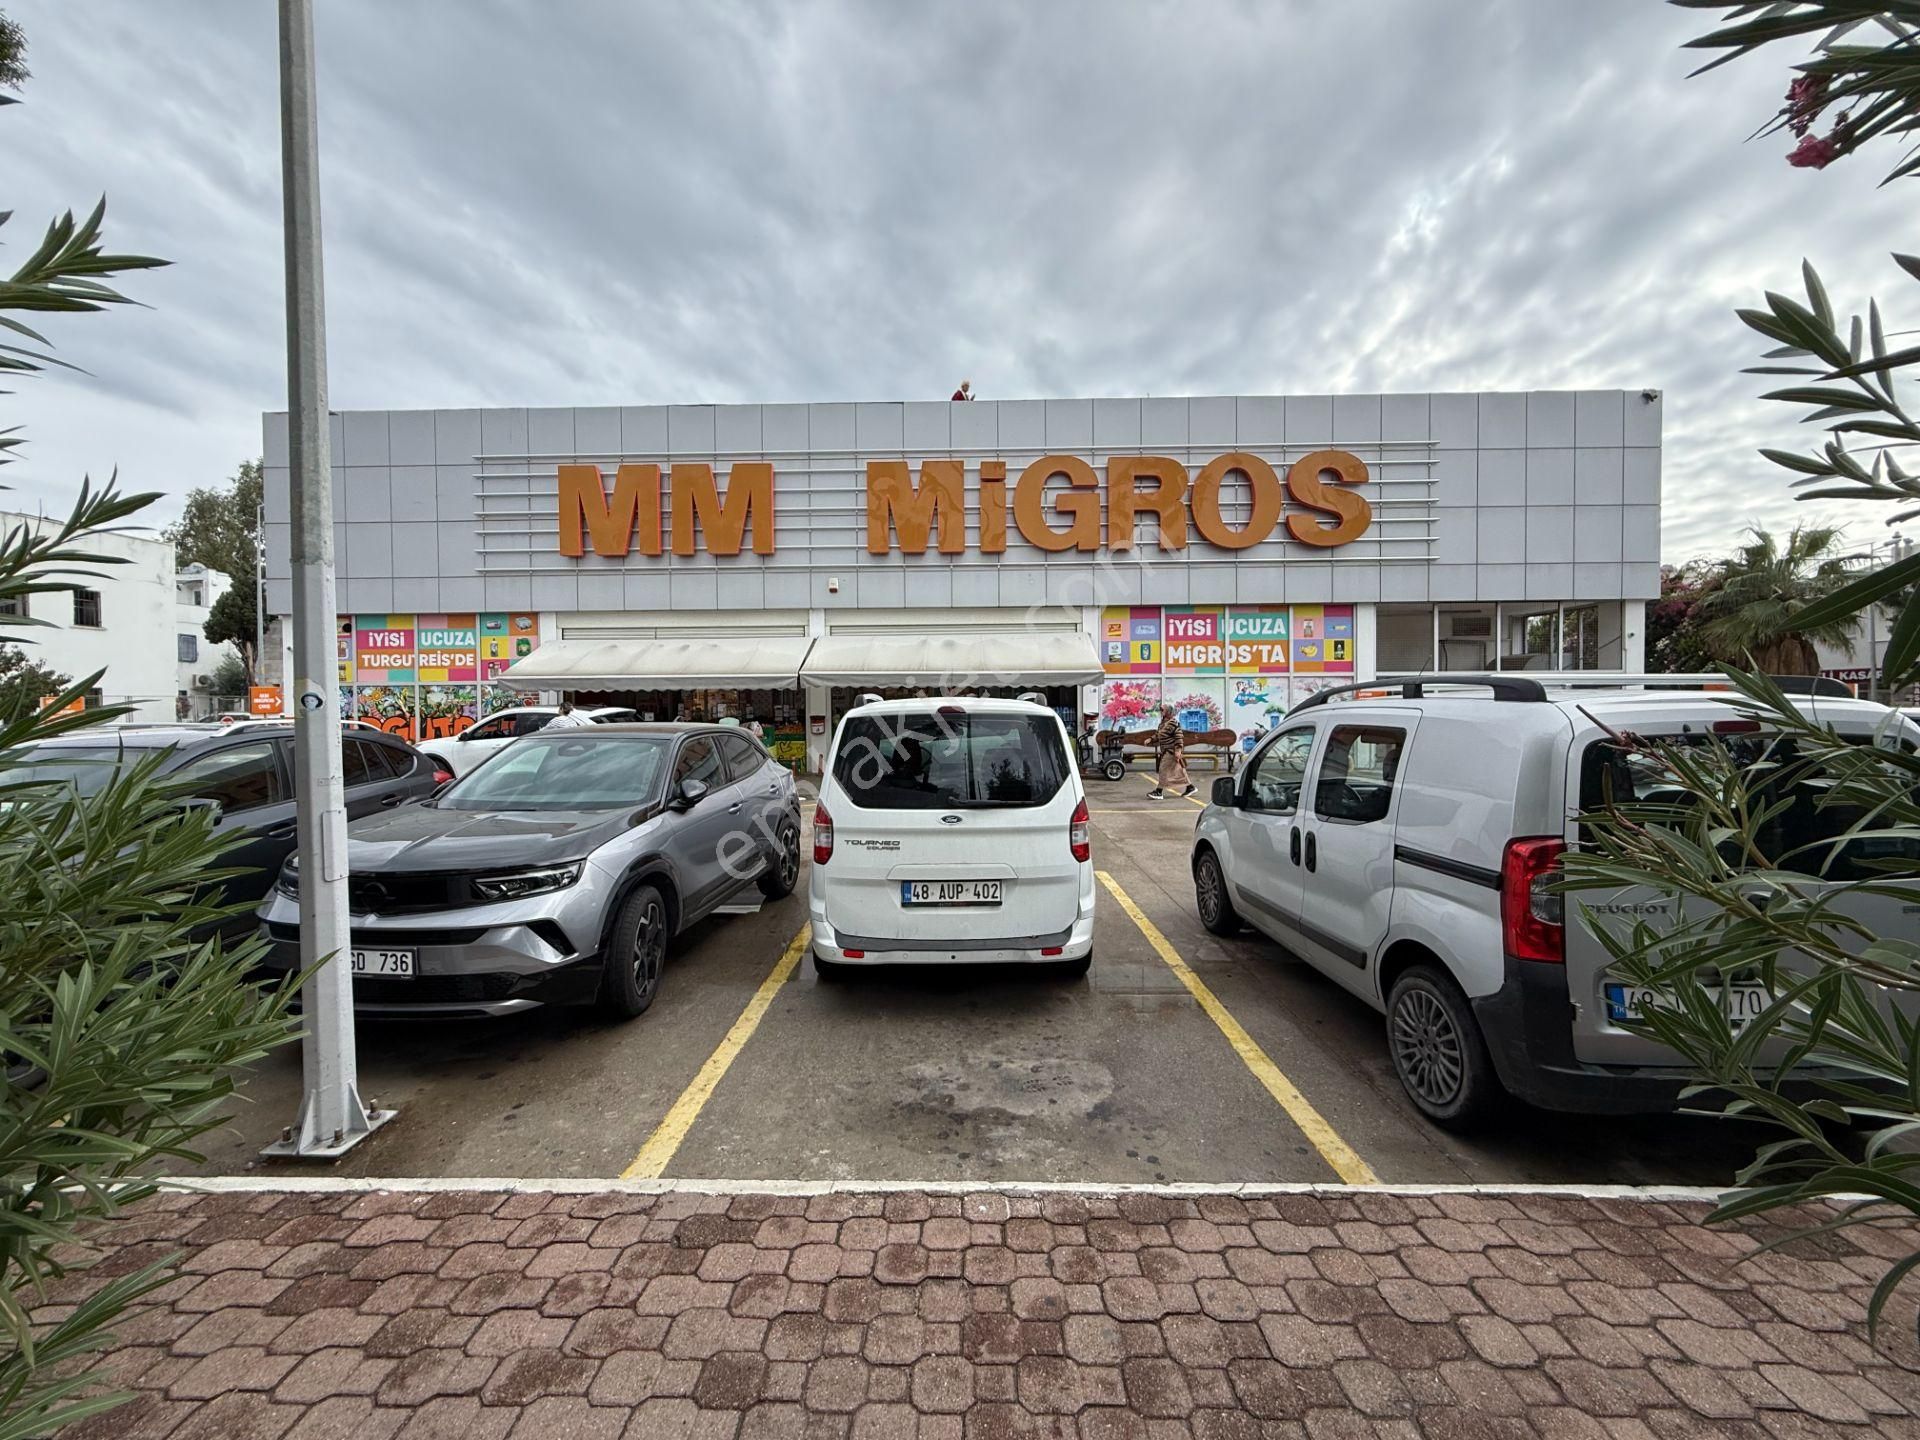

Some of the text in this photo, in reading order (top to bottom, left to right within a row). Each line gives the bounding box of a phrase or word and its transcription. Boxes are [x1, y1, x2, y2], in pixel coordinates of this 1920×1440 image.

[558, 449, 1372, 556] MM MiGROS
[1222, 618, 1286, 635] UCUZA
[421, 632, 475, 646] UCUZA
[912, 884, 929, 900] 48
[939, 884, 963, 900] AUP
[973, 883, 999, 899] 402
[380, 953, 409, 972] 736
